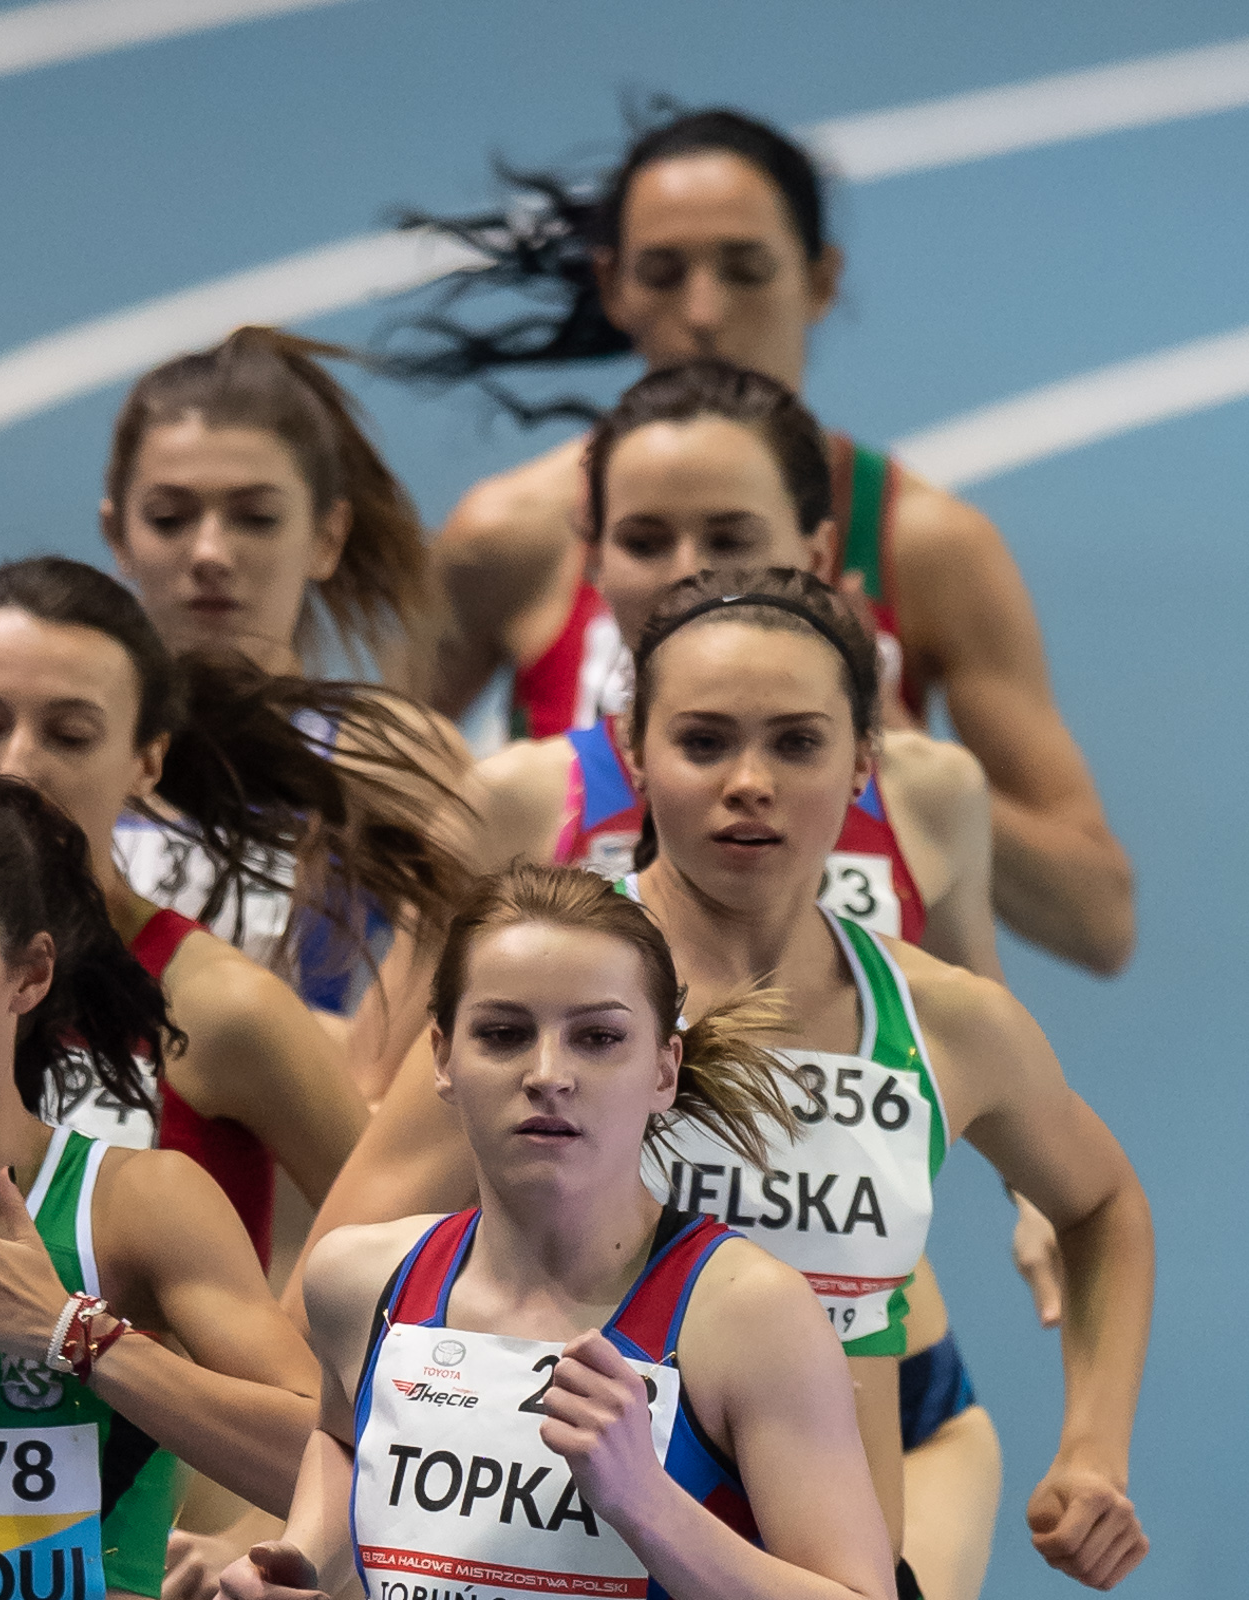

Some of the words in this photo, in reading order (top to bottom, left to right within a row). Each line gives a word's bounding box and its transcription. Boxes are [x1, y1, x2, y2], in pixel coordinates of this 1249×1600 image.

[791, 1064, 910, 1131] 356
[827, 1307, 856, 1333] 19
[423, 1366, 461, 1380] TOYOTA
[388, 1443, 600, 1537] TOPKA
[398, 1556, 454, 1574] HALOWE
[455, 1564, 569, 1589] MISTRZOSTWA
[572, 1579, 628, 1593] POLSKI
